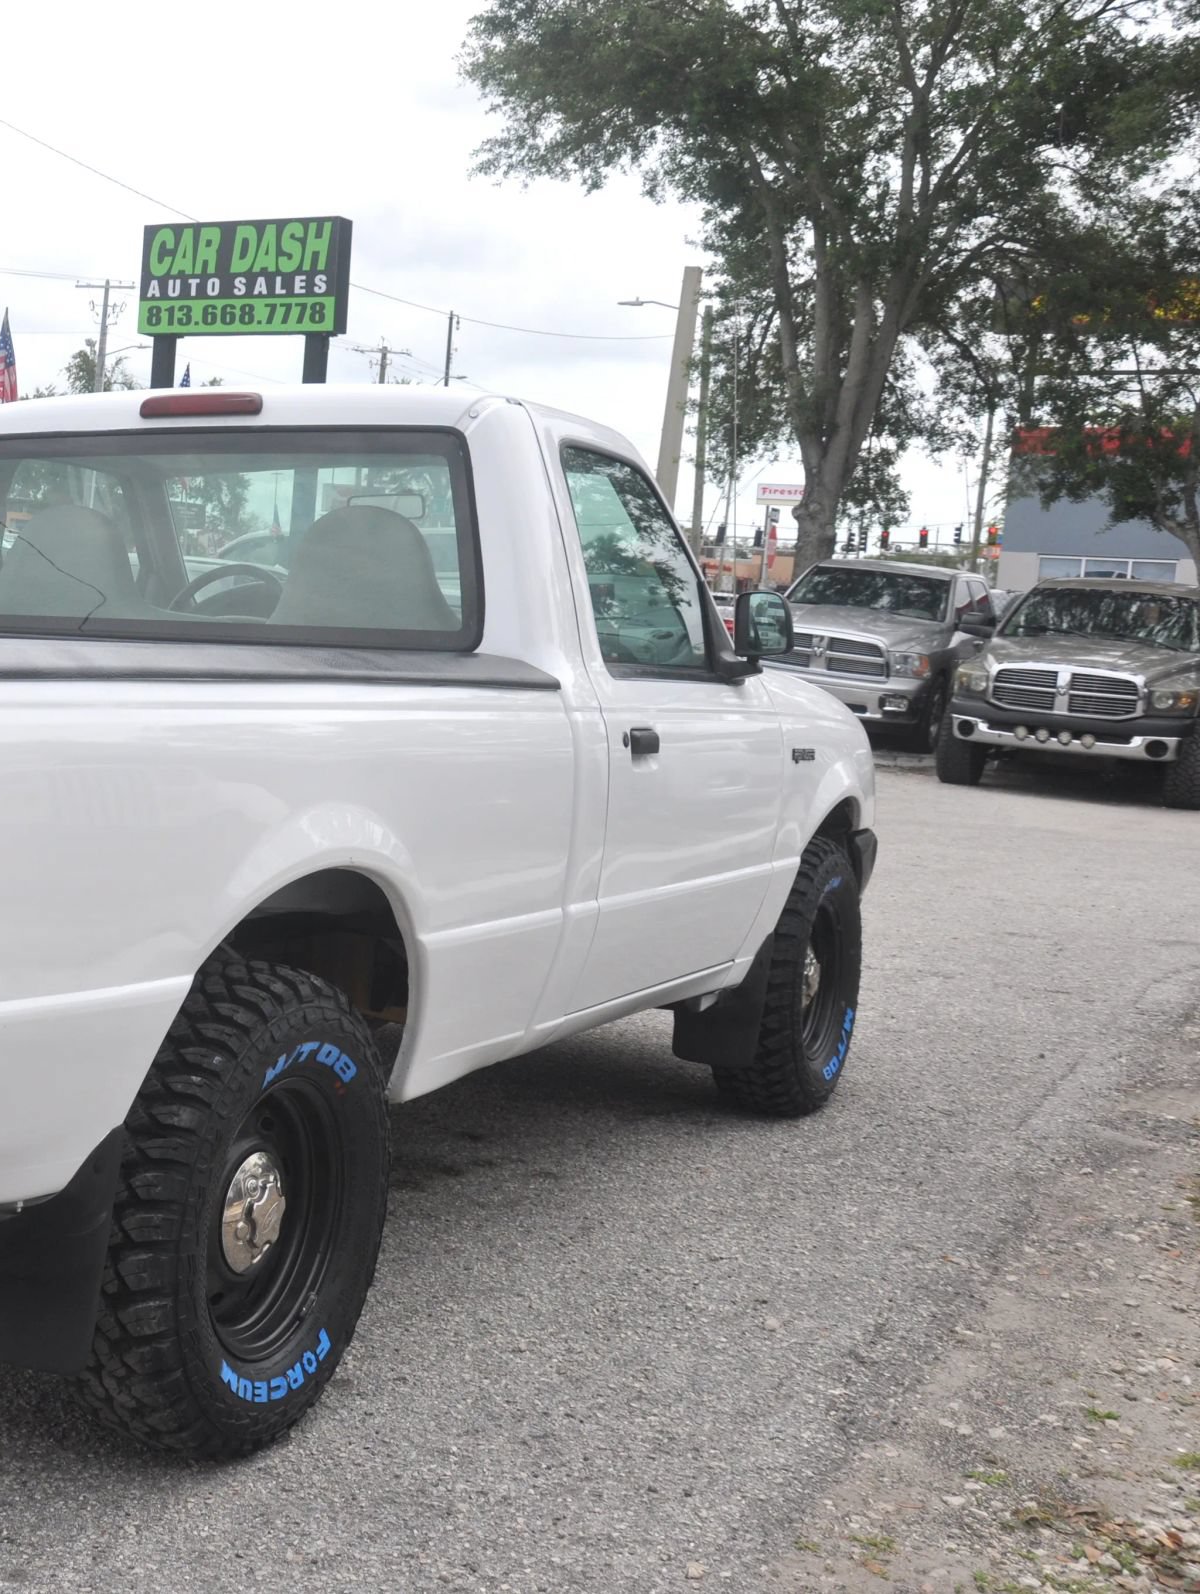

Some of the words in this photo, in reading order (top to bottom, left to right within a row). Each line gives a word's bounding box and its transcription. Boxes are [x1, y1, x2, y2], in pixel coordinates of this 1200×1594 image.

[149, 226, 221, 277] CAR
[230, 221, 333, 274] DASH
[147, 278, 220, 298] AUTO
[234, 274, 328, 296] SALES
[146, 302, 326, 327] 813.668.7778
[220, 1327, 332, 1403] FORCEUM
